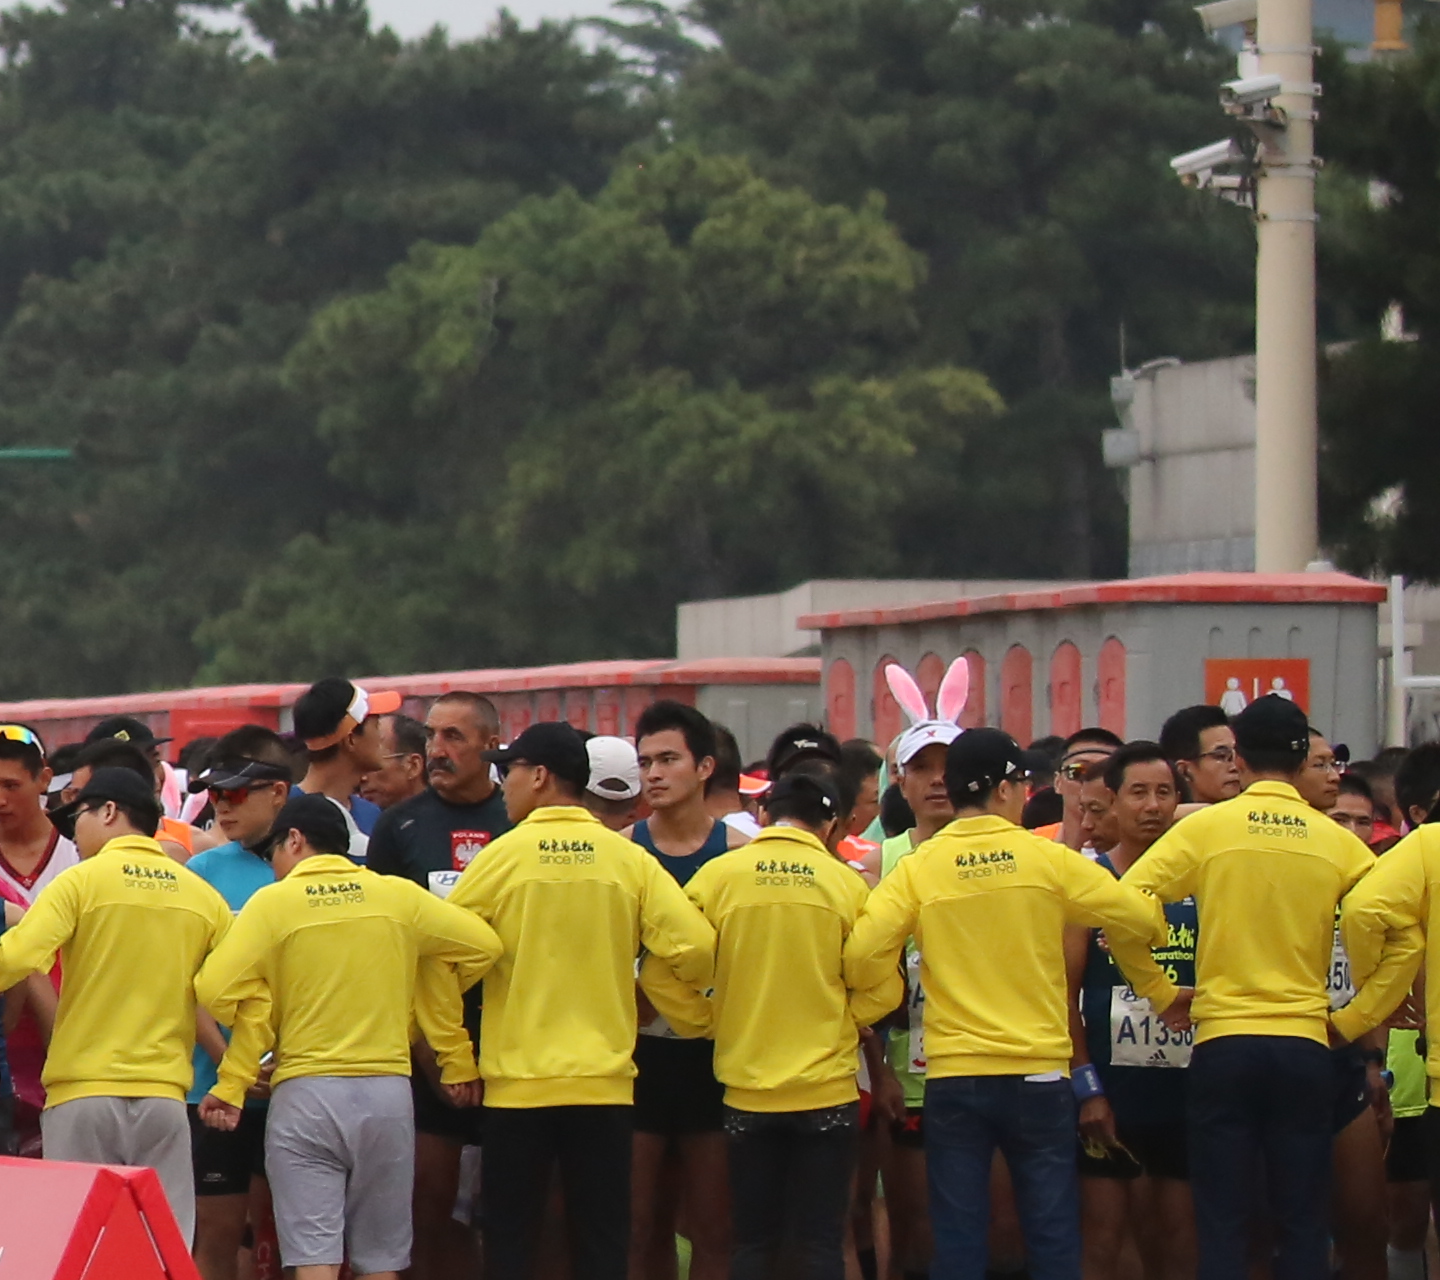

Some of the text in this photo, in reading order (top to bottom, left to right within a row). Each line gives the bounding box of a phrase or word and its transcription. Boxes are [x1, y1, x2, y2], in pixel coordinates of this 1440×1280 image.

[1248, 824, 1309, 840] since 1981
[538, 852, 596, 867] since 1981
[957, 861, 1017, 881] since 1981
[124, 878, 179, 893] since 1981
[755, 874, 816, 889] since 1981
[308, 891, 366, 908] since 1981
